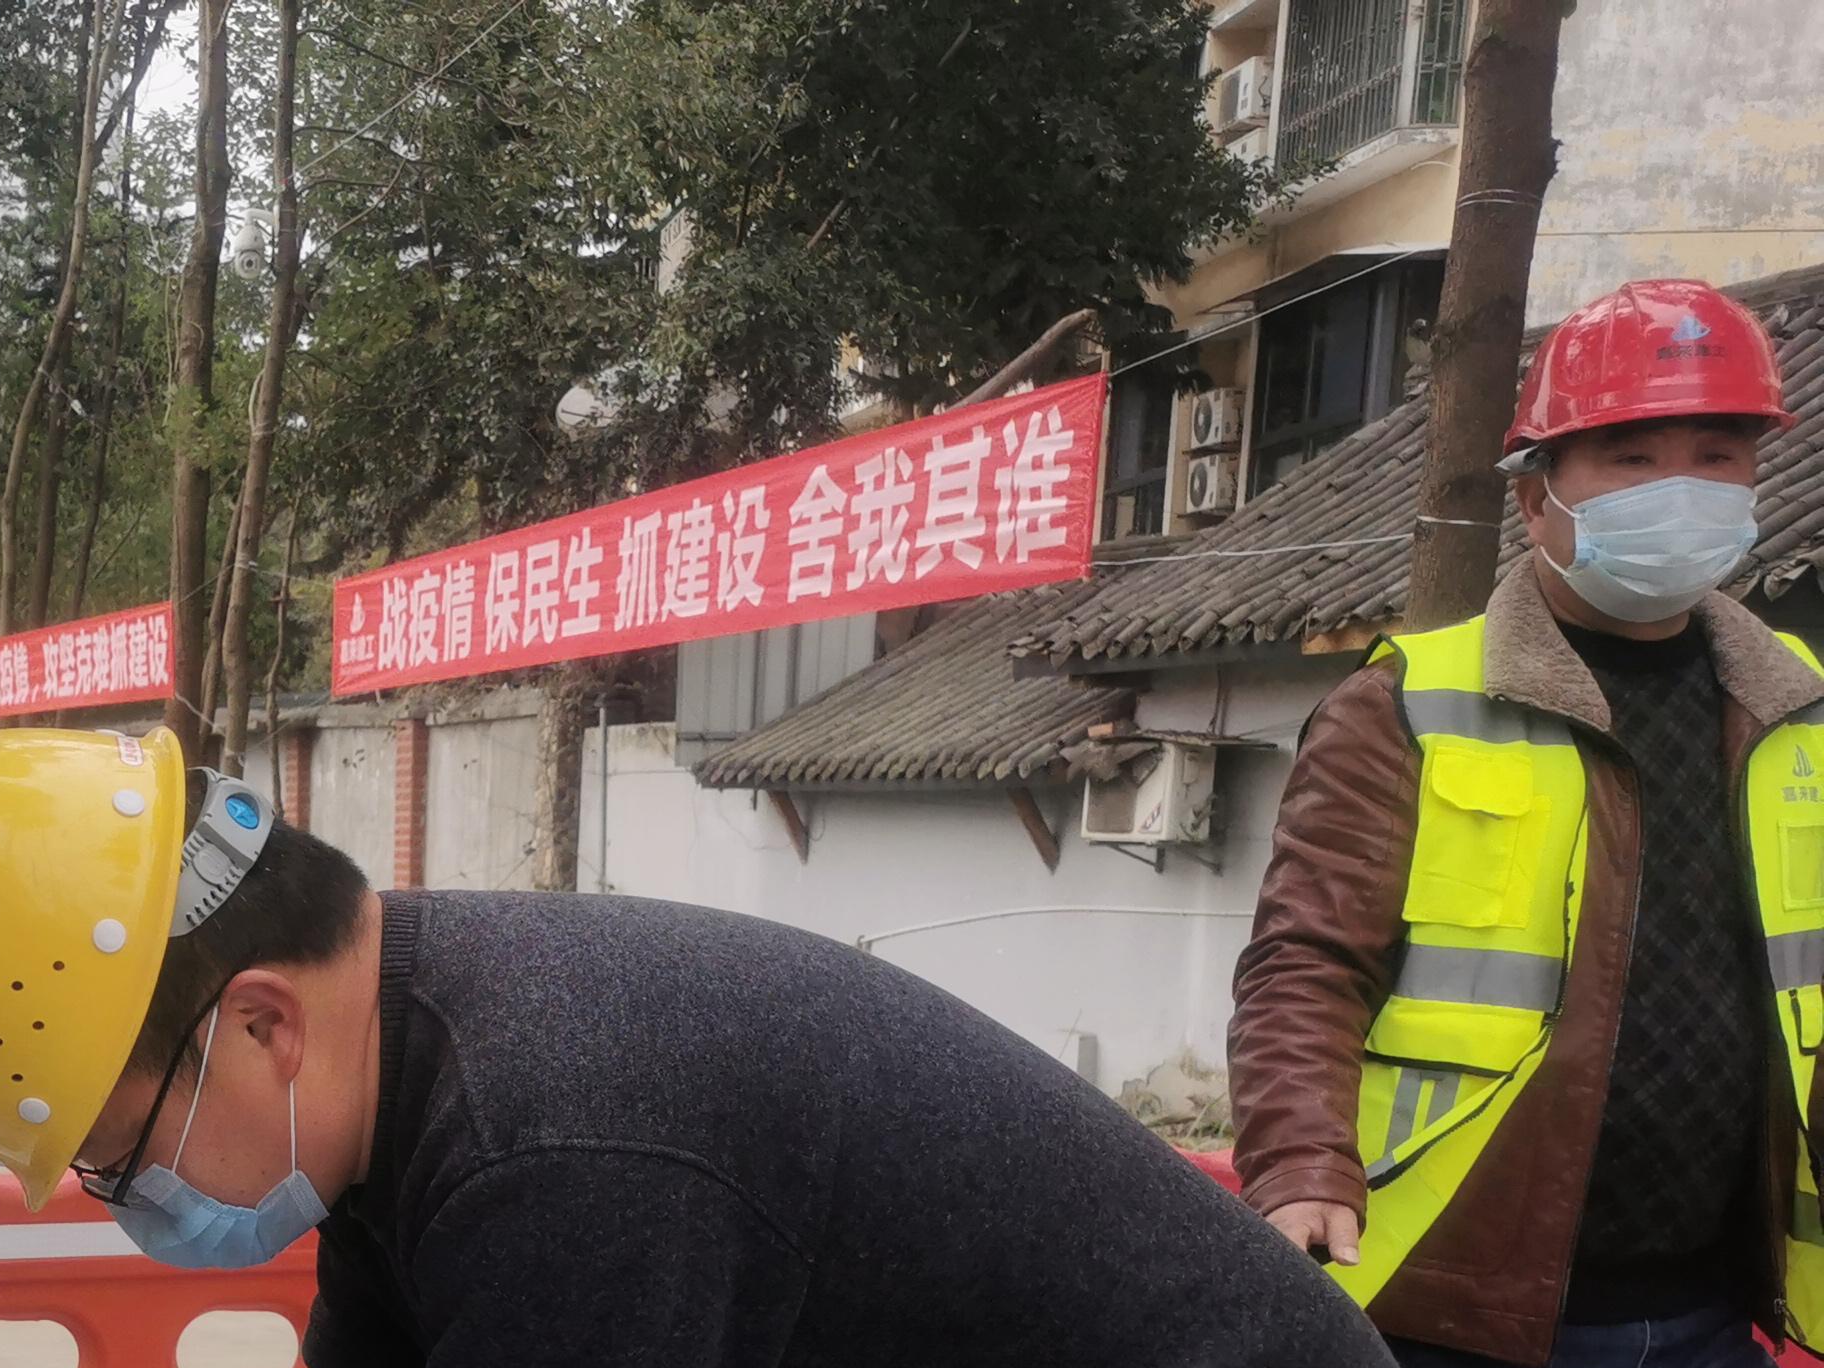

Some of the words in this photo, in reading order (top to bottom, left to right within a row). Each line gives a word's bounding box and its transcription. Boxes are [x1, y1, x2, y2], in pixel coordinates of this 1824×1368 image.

[377, 558, 473, 672] 战疫情
[482, 525, 604, 657] 保民生
[612, 483, 773, 632] 抓建设
[784, 403, 1077, 605] 舍我其谁
